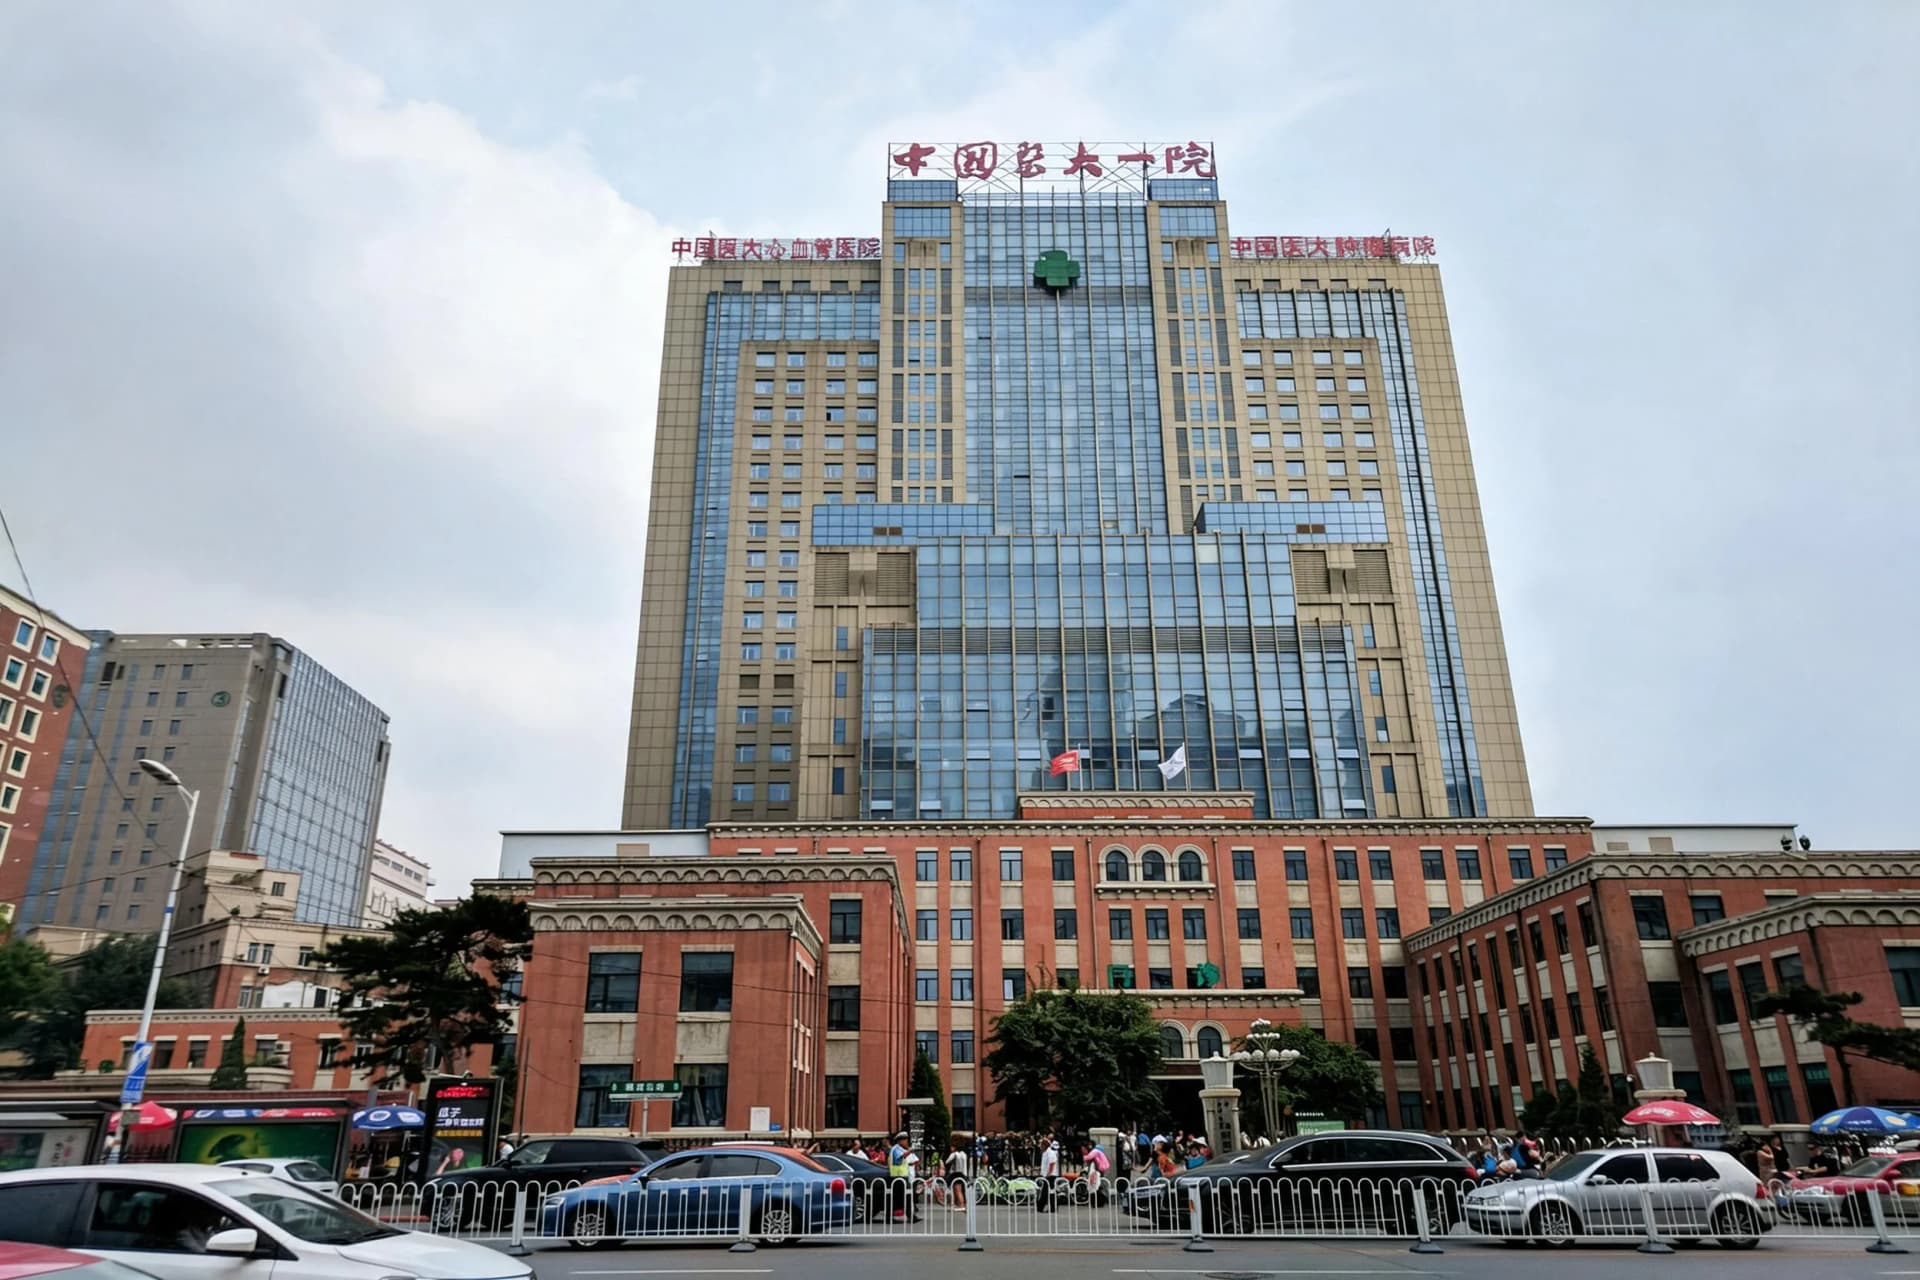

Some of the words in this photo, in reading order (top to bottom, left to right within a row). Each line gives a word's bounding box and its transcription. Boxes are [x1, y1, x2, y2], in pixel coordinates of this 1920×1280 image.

[672, 237, 881, 259] 中国医大心血管医院
